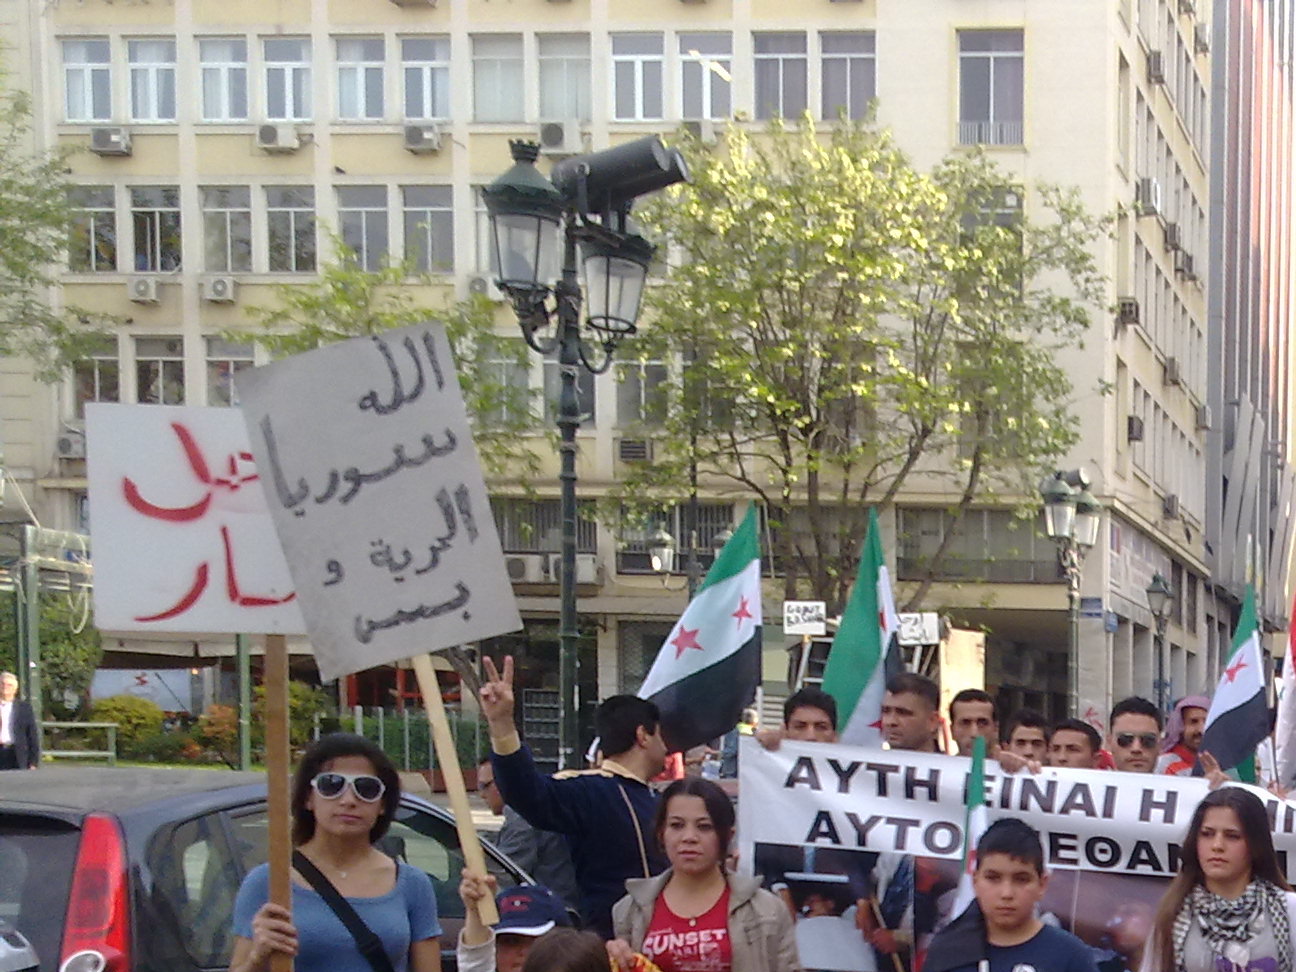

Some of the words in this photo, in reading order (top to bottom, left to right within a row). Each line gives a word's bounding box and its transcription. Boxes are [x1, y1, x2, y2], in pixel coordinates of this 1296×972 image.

[359, 331, 444, 415] الله
[260, 413, 457, 516] سوريا
[784, 755, 941, 802] ΑΥΤΗ
[1139, 788, 1179, 824] Η
[805, 810, 962, 856] ΑΥΤΟ
[642, 928, 727, 959] SUNSET
